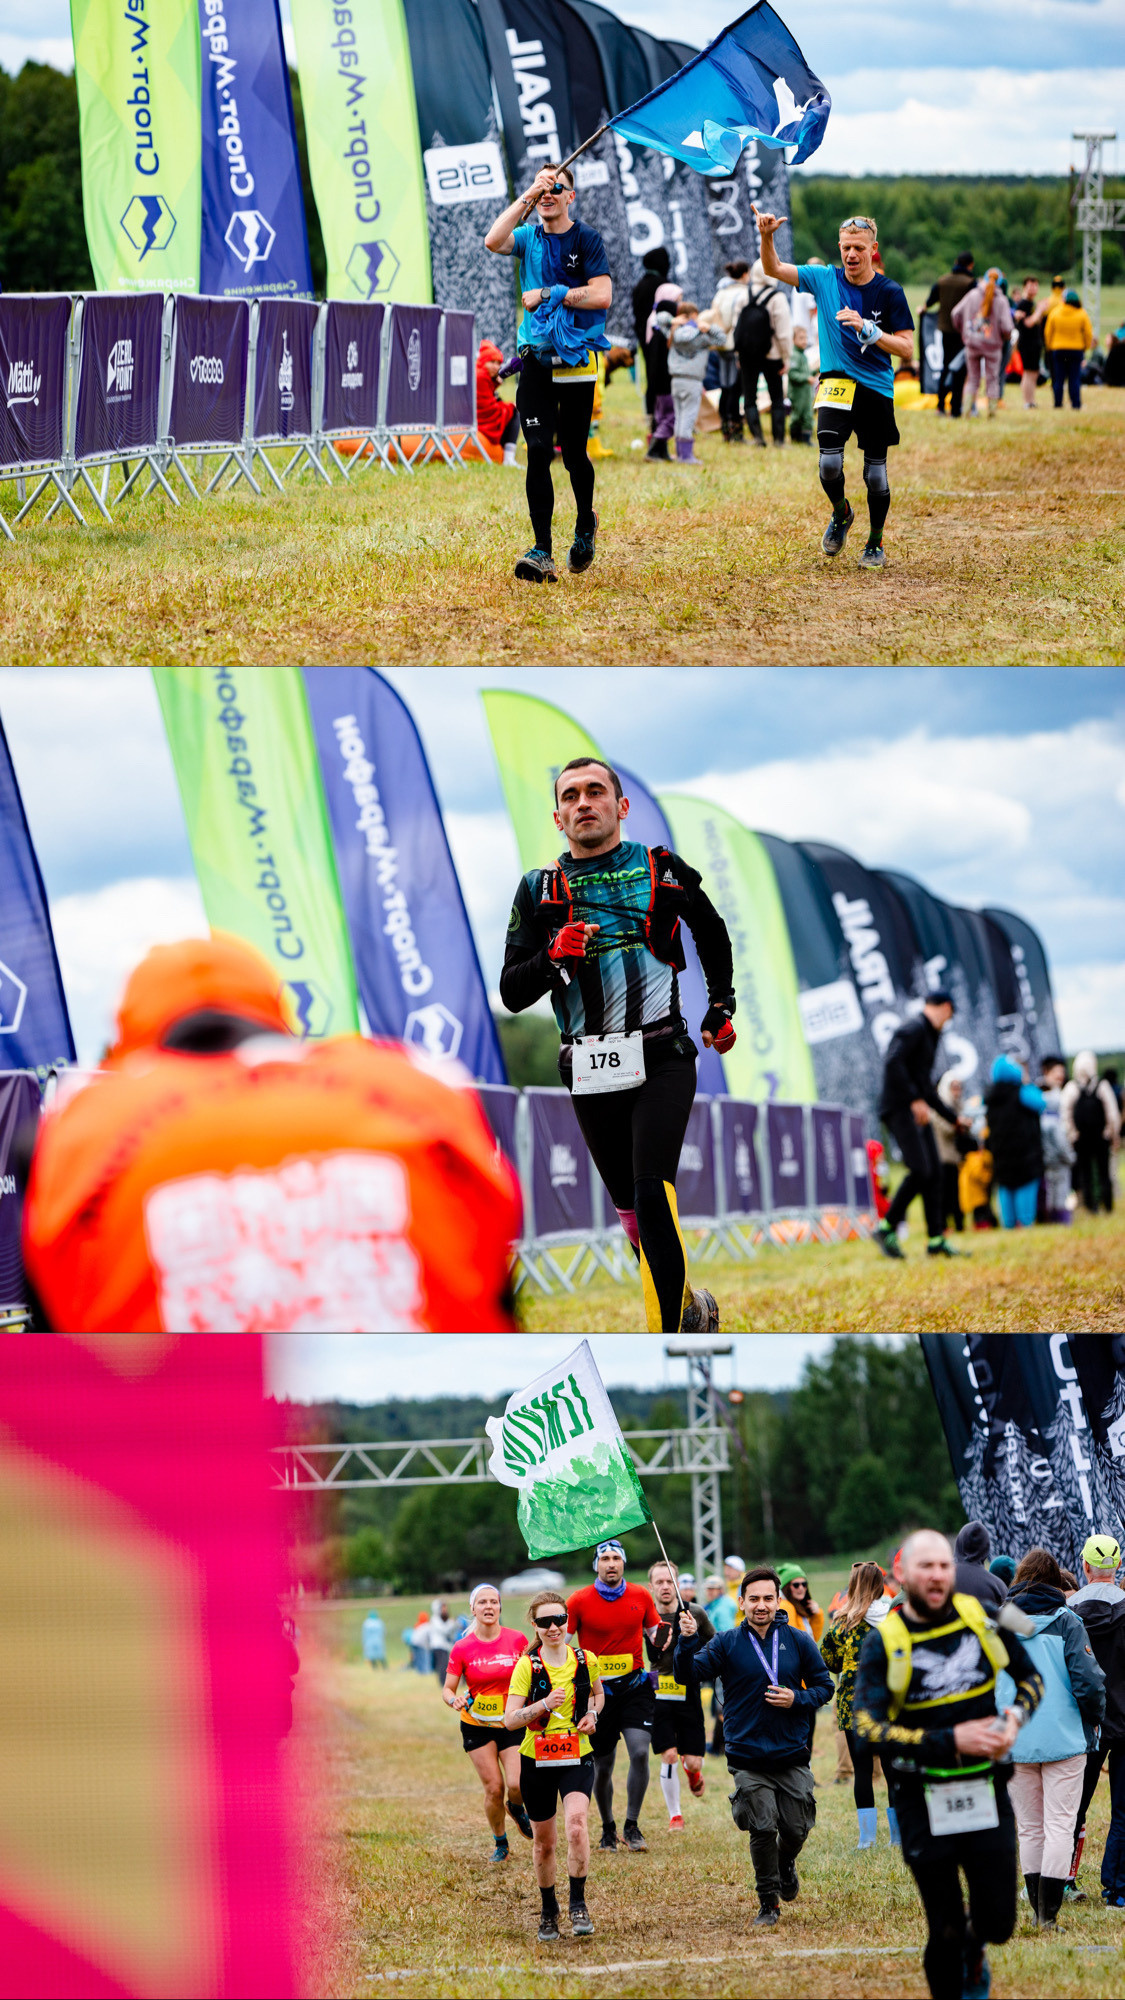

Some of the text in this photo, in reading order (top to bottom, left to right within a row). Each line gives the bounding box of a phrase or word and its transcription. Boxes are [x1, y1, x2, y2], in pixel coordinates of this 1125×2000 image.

[8, 360, 33, 394] Mätti
[116, 365, 133, 391] POINT
[823, 387, 846, 397] 3257
[590, 1052, 621, 1070] 178
[603, 1662, 627, 1671] 3209
[477, 1701, 498, 1711] 3208
[542, 1742, 573, 1753] 4042
